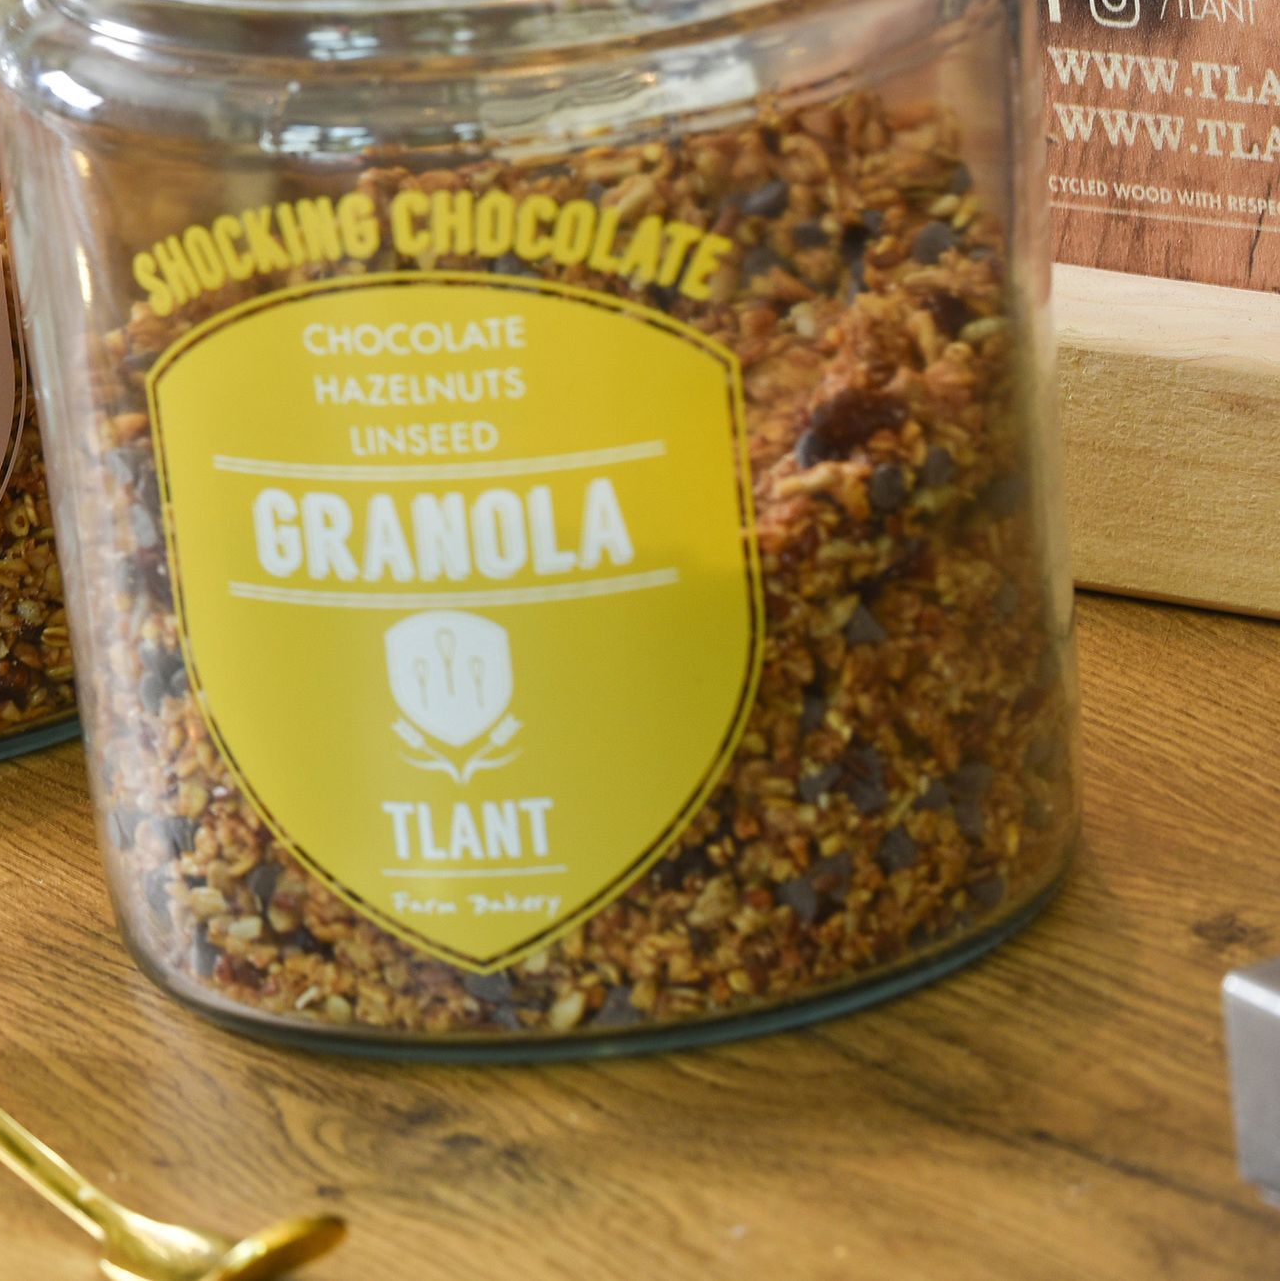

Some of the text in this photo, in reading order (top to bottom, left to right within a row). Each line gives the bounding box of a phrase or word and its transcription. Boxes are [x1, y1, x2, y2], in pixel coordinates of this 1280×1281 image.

[1113, 183, 1173, 205] WOOD
[1176, 190, 1222, 210] WITH
[1228, 195, 1280, 217] RESPE
[132, 189, 734, 317] SHOCKING CHOCOLATE
[301, 316, 528, 357] CHOCOLATE
[313, 368, 527, 407] HAZELNUTS
[349, 421, 500, 456] LINSEED
[250, 477, 636, 583] GRANOLA
[381, 798, 555, 860] TLANT
